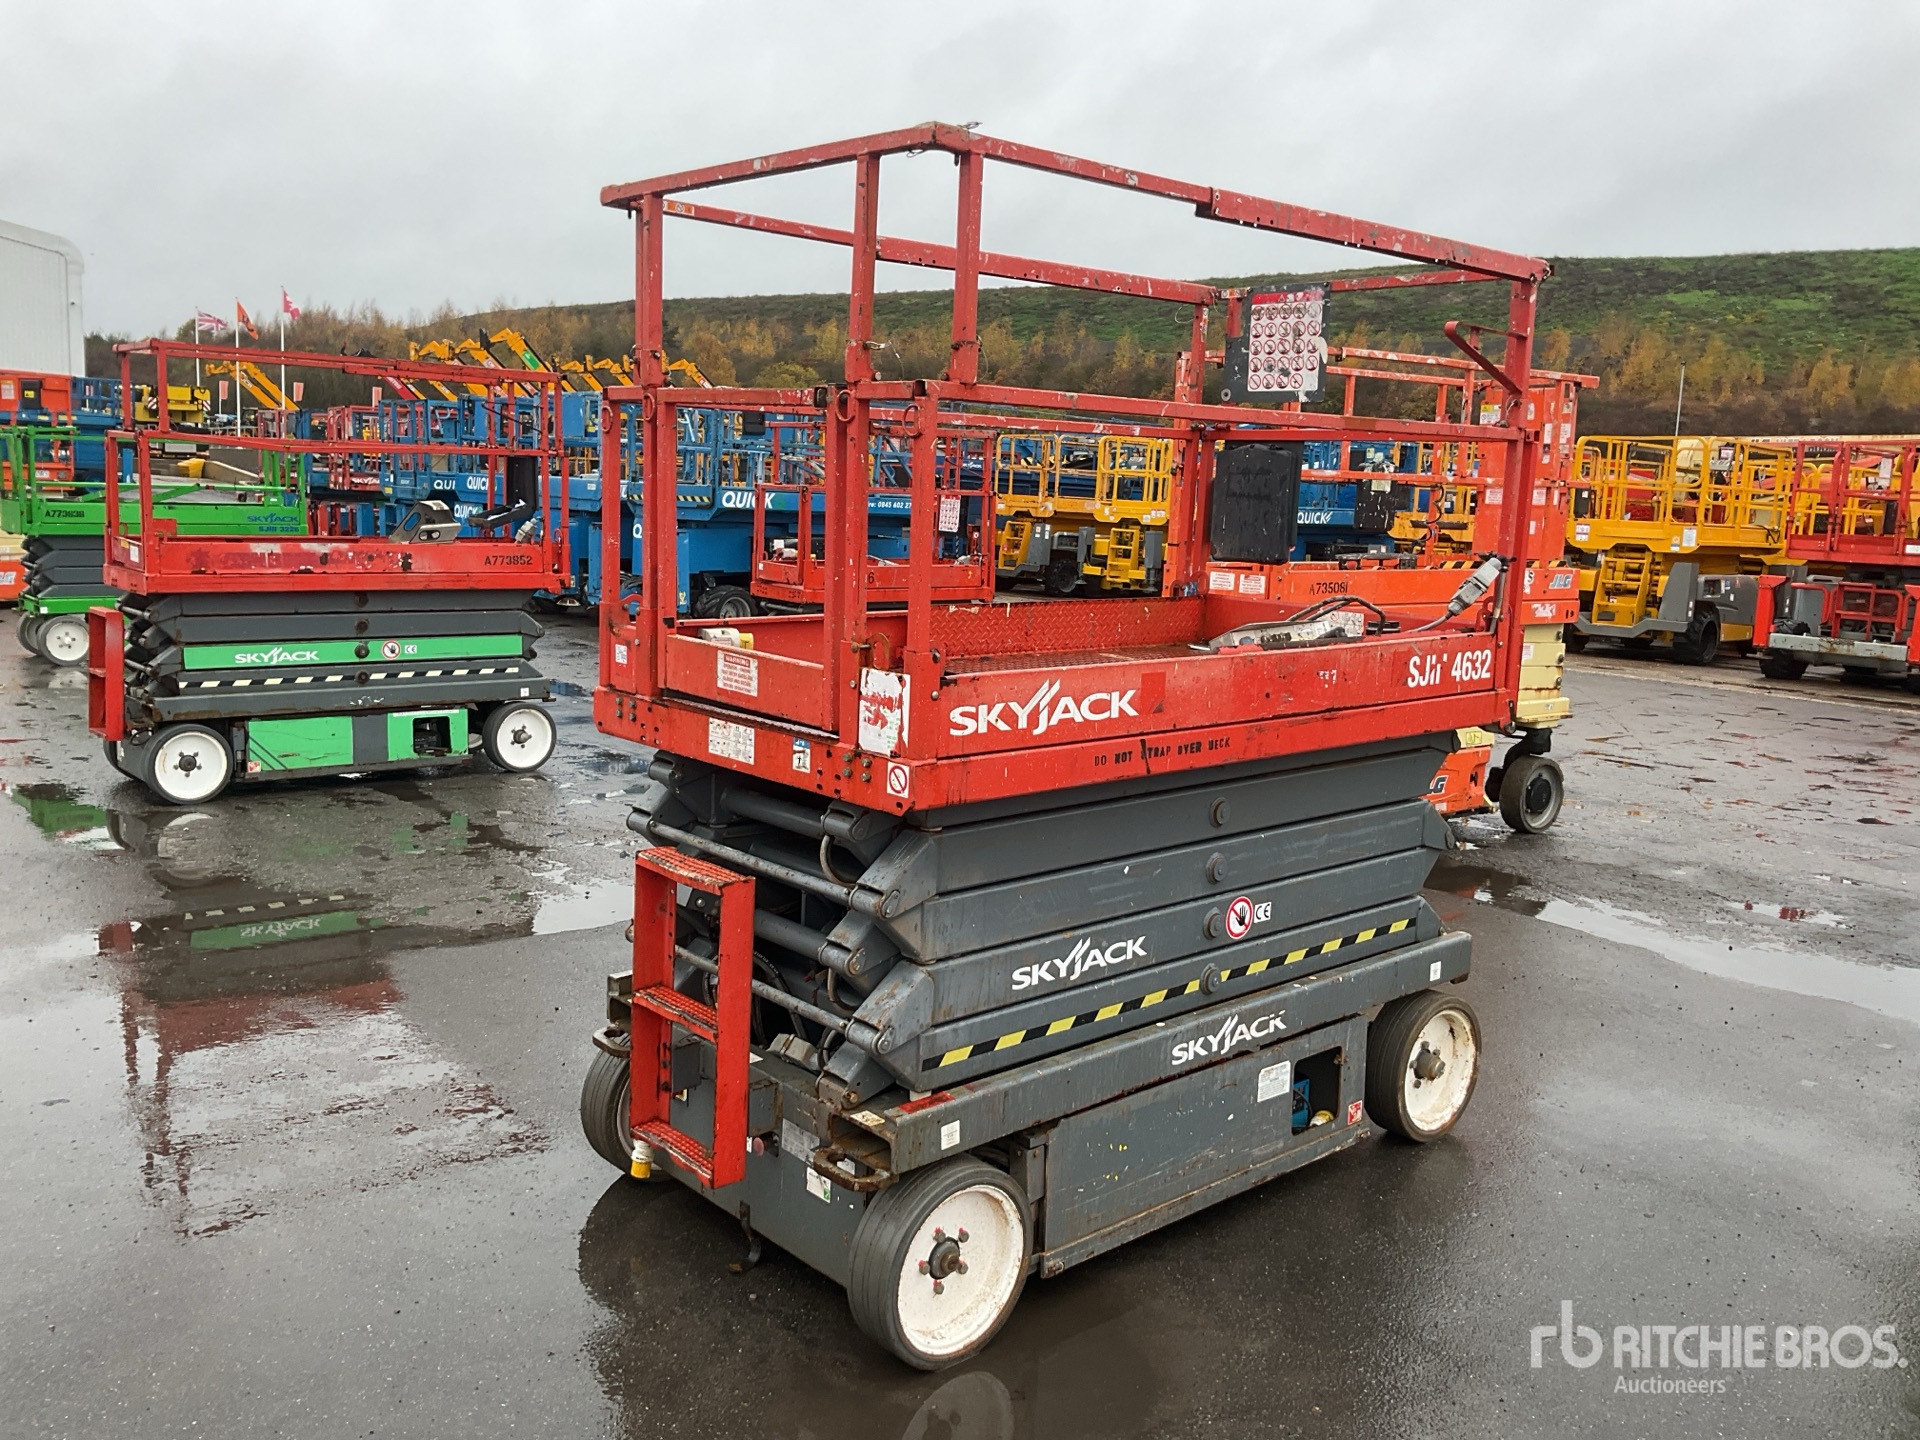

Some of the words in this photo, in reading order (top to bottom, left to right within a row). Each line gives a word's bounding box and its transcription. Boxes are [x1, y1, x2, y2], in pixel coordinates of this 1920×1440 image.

[721, 490, 776, 509] QUIK
[246, 512, 299, 523] SKYJACK
[1296, 511, 1330, 525] QUICK
[1549, 573, 1573, 589] JLG
[233, 647, 320, 664] SKYJACK
[1450, 649, 1492, 682] 4632
[949, 678, 1140, 737] SKYJACK
[1094, 755, 1107, 767] DO
[1114, 750, 1133, 764] NOT
[1177, 741, 1202, 756] OVER
[1208, 736, 1231, 751] DECK
[1011, 935, 1147, 991] SKYJACK
[1171, 1009, 1288, 1066] SKYJACK
